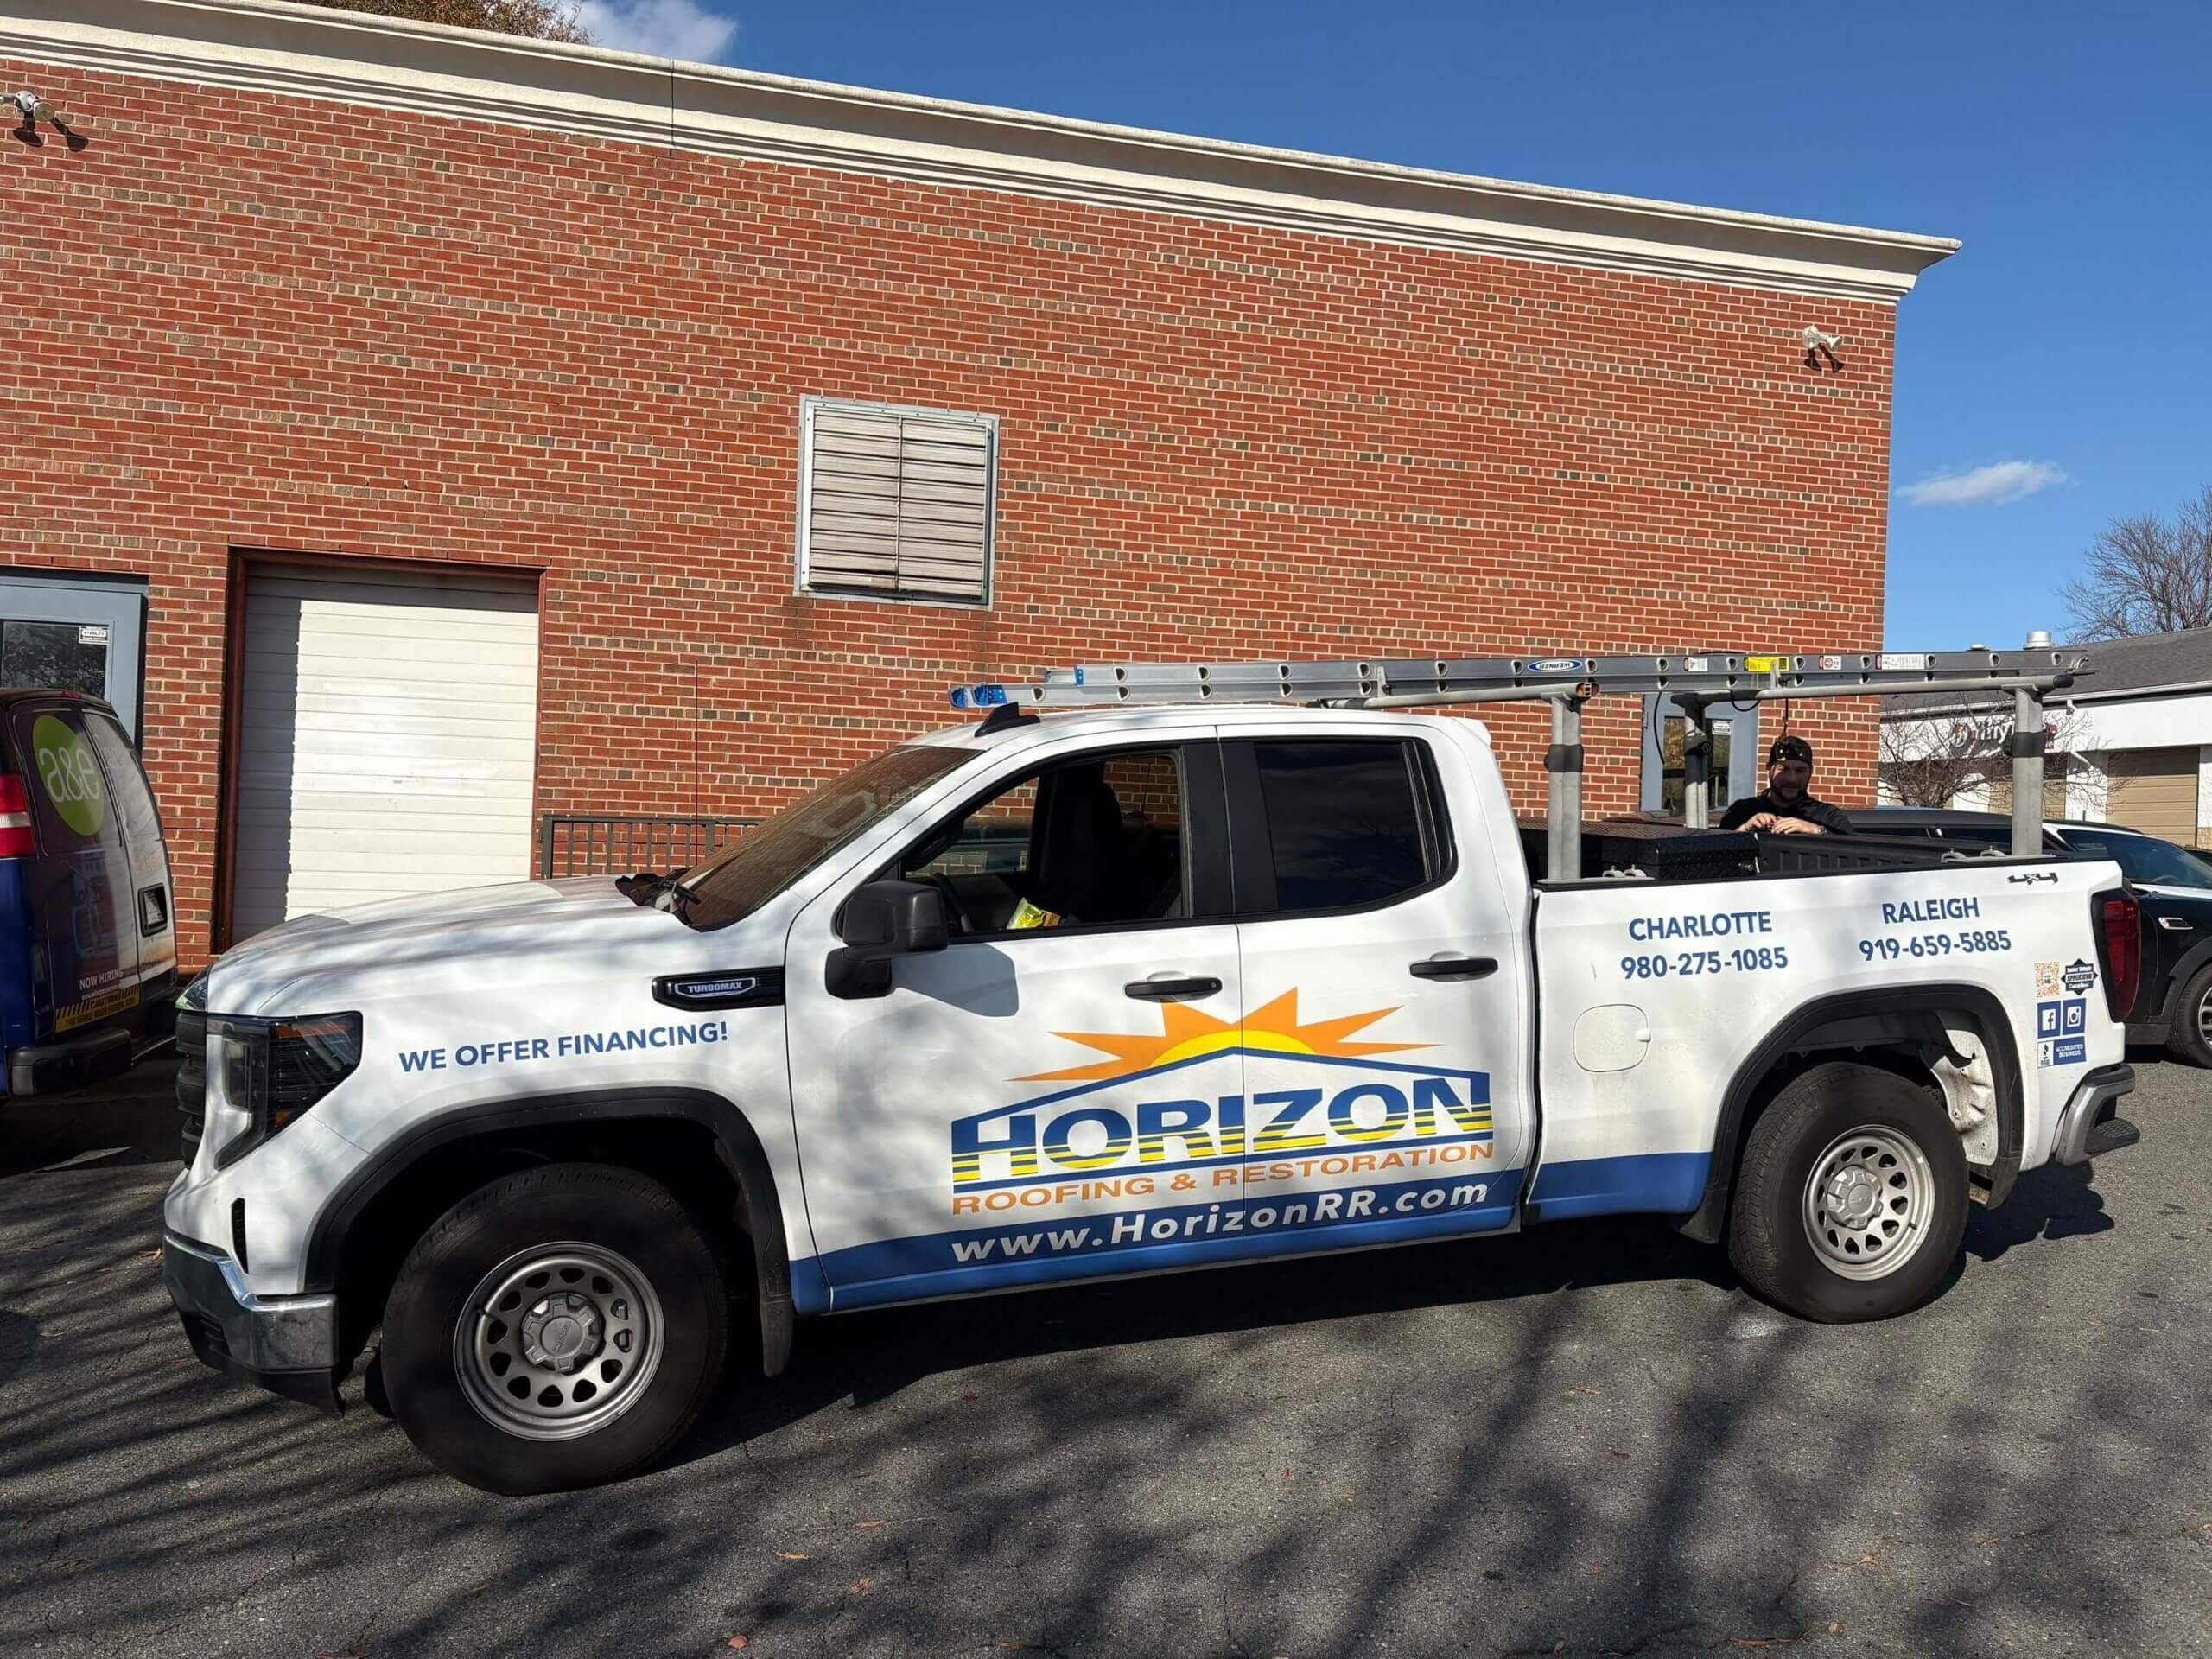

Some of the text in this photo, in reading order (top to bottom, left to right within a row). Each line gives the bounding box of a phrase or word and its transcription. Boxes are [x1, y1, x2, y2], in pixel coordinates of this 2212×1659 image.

[1628, 911, 1772, 940] CHARLOTTE
[1881, 897, 1980, 924] RALEIGH
[1859, 930, 2012, 961] 919-659-5885
[1620, 947, 1789, 979] 980-275-1085
[79, 976, 98, 990] NOW
[687, 981, 743, 994] TURBOMAX
[398, 1021, 728, 1072] WE OFFER FINANCING!
[2056, 1043, 2083, 1052] ACCREDITED
[951, 1073, 1494, 1182] HORIZON
[953, 1142, 1494, 1215] ROOFING & RESTORATION
[951, 1180, 1489, 1262] www.HorizonRR.com
